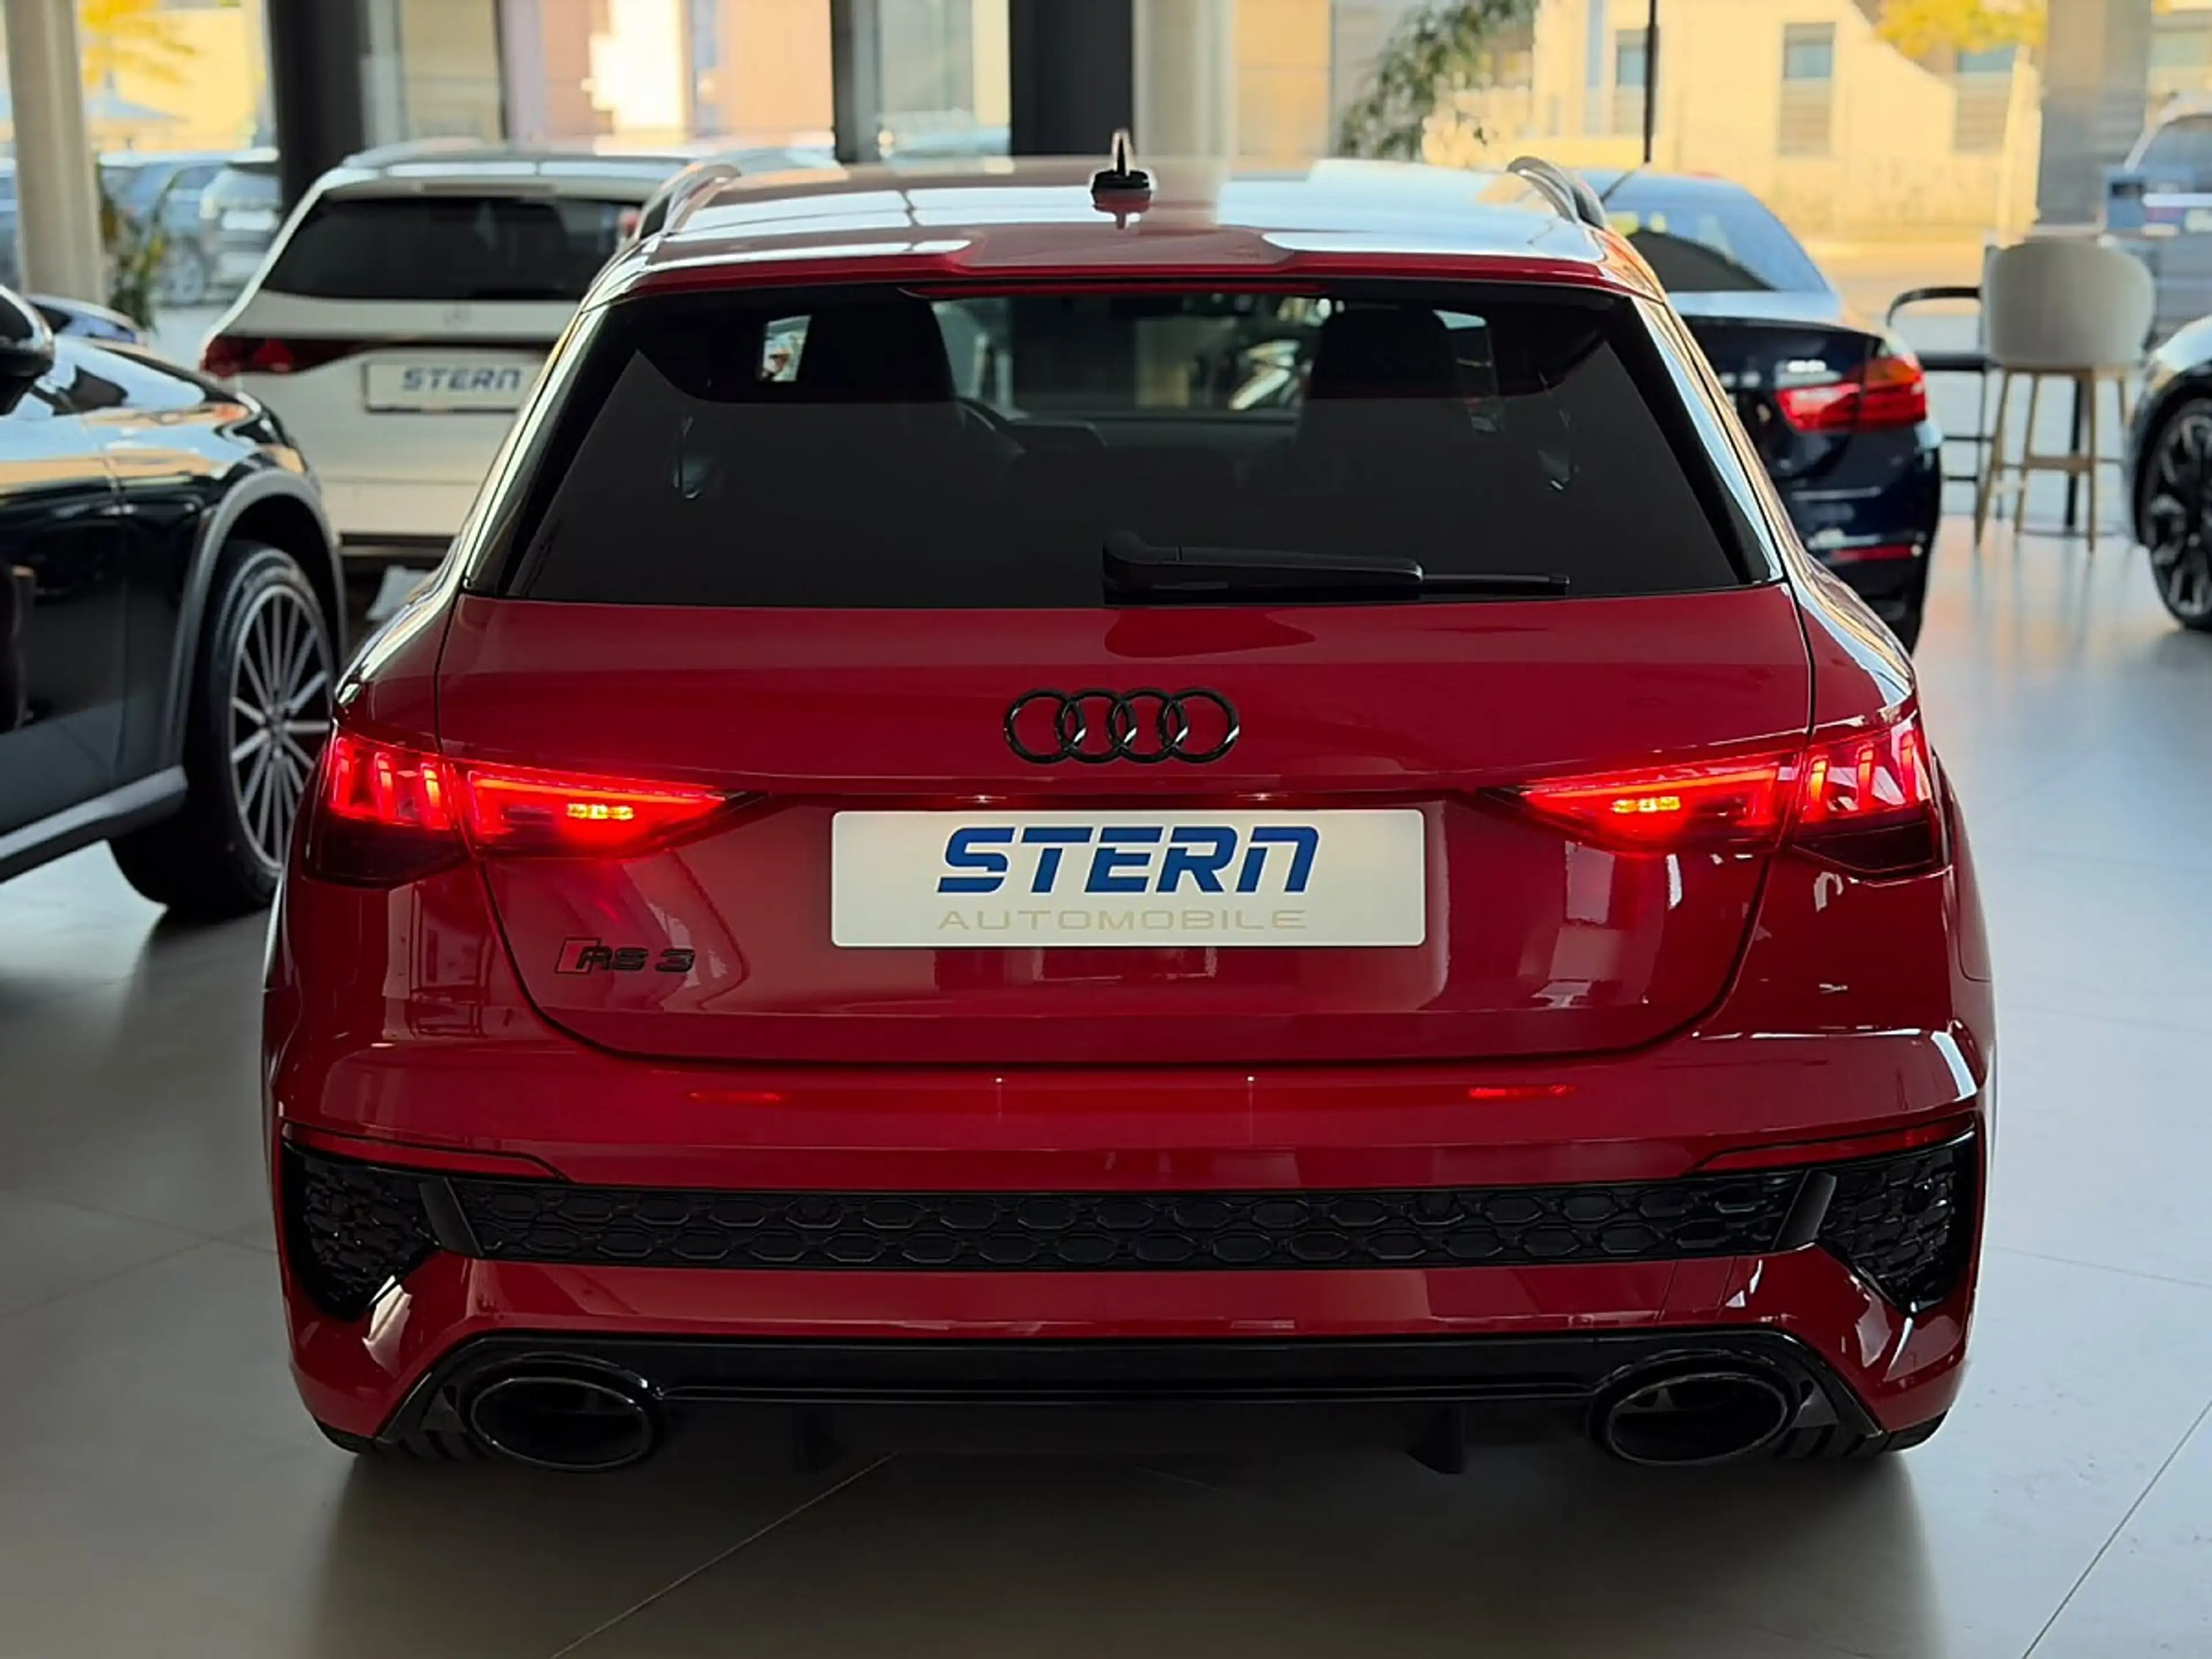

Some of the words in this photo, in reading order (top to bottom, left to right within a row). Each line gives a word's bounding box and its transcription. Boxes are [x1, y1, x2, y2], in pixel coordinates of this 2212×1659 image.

[937, 826, 1320, 893] STERN
[937, 910, 1308, 930] AUTOMOBILE
[575, 946, 649, 971] RS
[655, 948, 695, 972] 3
